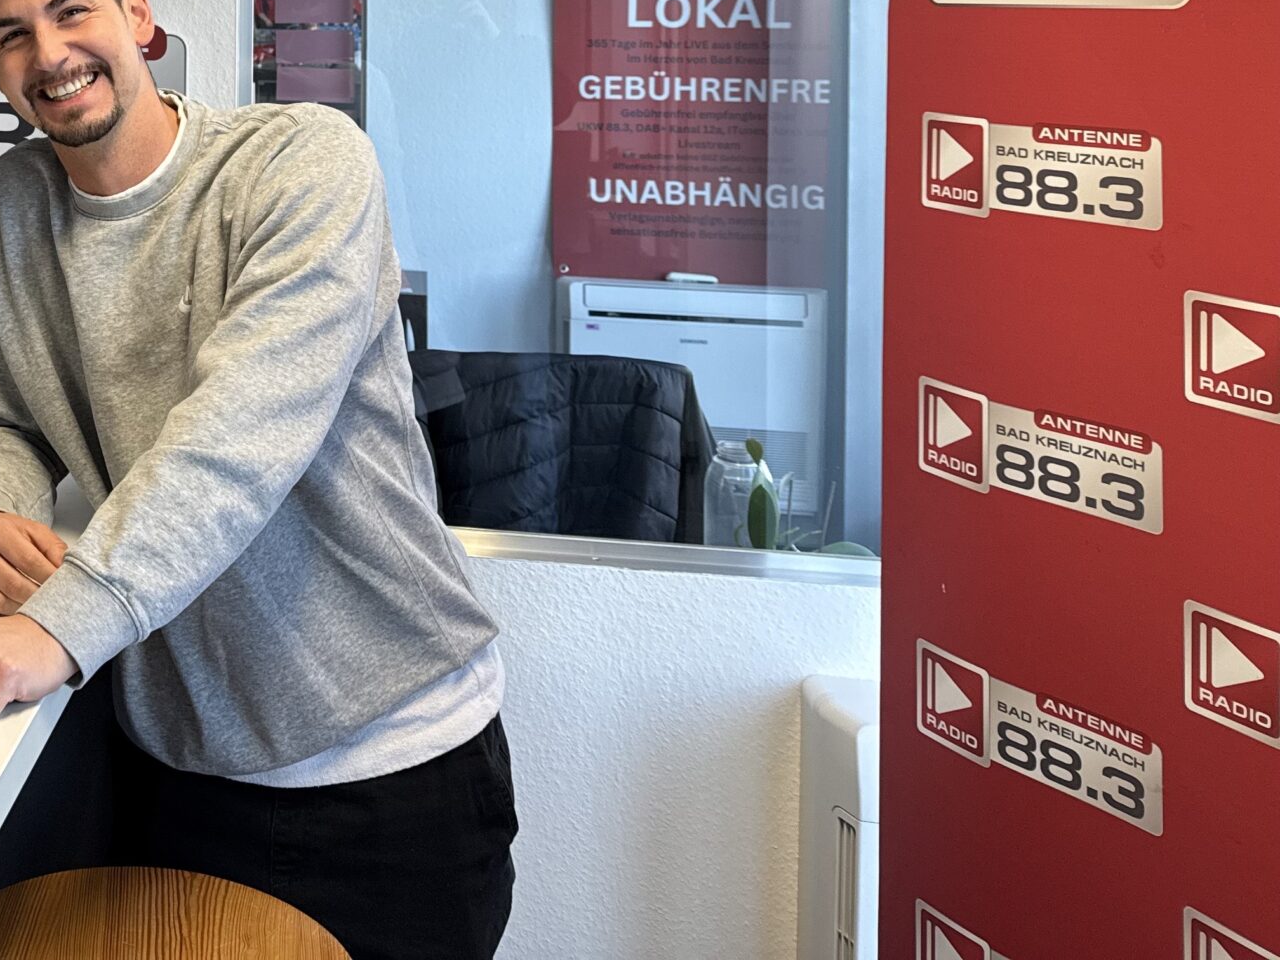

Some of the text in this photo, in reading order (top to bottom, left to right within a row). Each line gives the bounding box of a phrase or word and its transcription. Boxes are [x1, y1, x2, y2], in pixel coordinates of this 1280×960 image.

[683, 41, 709, 50] LIVE
[1038, 126, 1142, 147] ANTENNE
[996, 145, 1144, 171] BAD KREUZNACH
[589, 176, 825, 209] UNABHÄNGIG
[930, 184, 979, 203] RADIO
[995, 164, 1144, 221] 88.3
[1199, 375, 1273, 406] RADIO
[995, 424, 1145, 472] BAD KREUZNACH
[1040, 413, 1144, 449] ANTENNE
[927, 449, 978, 477] RADIO
[995, 443, 1145, 521] 88.3
[1042, 698, 1145, 750] ANTENNE
[1198, 687, 1273, 730] RADIO
[926, 713, 978, 750] RADIO
[997, 700, 1146, 772] BAD KREUZNACH
[997, 721, 1145, 820] 88.3
